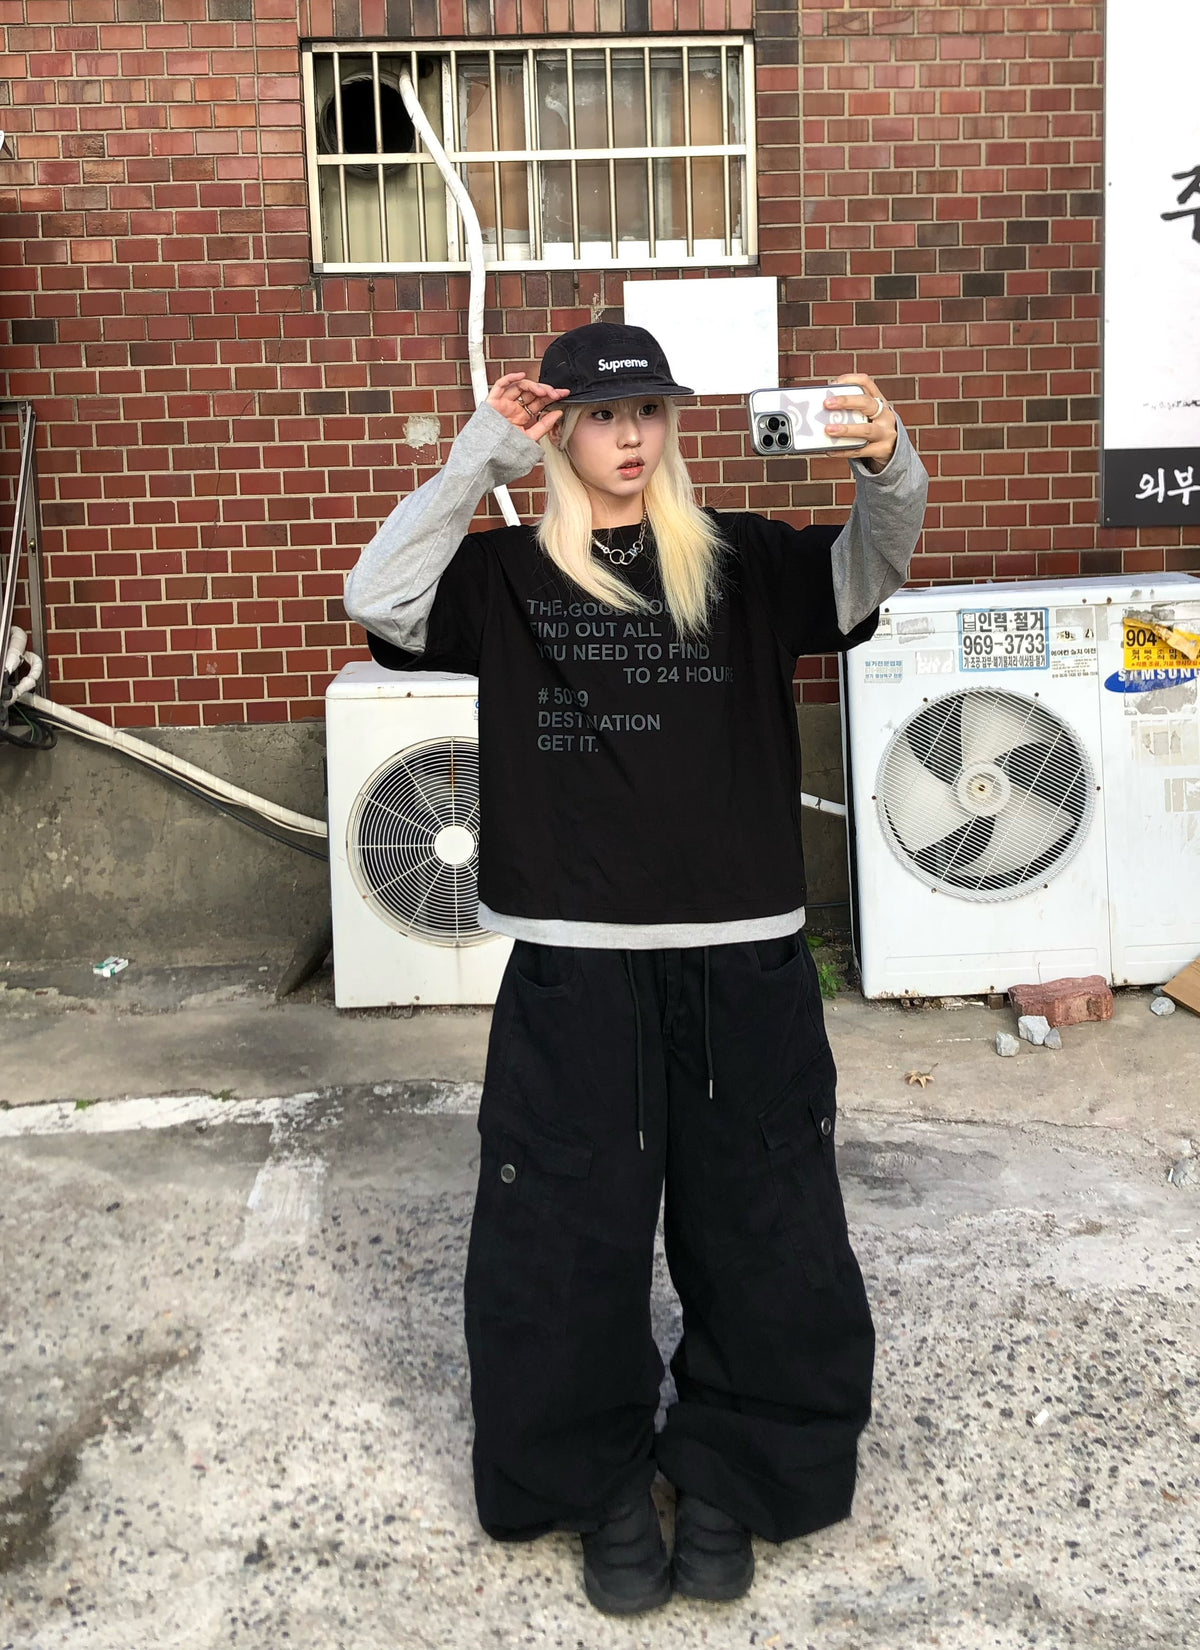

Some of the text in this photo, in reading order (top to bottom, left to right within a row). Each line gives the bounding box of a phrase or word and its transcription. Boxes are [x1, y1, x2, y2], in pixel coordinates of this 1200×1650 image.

[598, 358, 649, 373] Supreme
[529, 622, 662, 639] FIND OUT ALL
[573, 644, 629, 661] NEED
[635, 644, 662, 660] TO
[668, 643, 710, 660] FIND
[963, 633, 1045, 655] 969-3733
[623, 667, 651, 684] TO
[657, 667, 680, 683] 24
[537, 735, 599, 753] GET IT.
